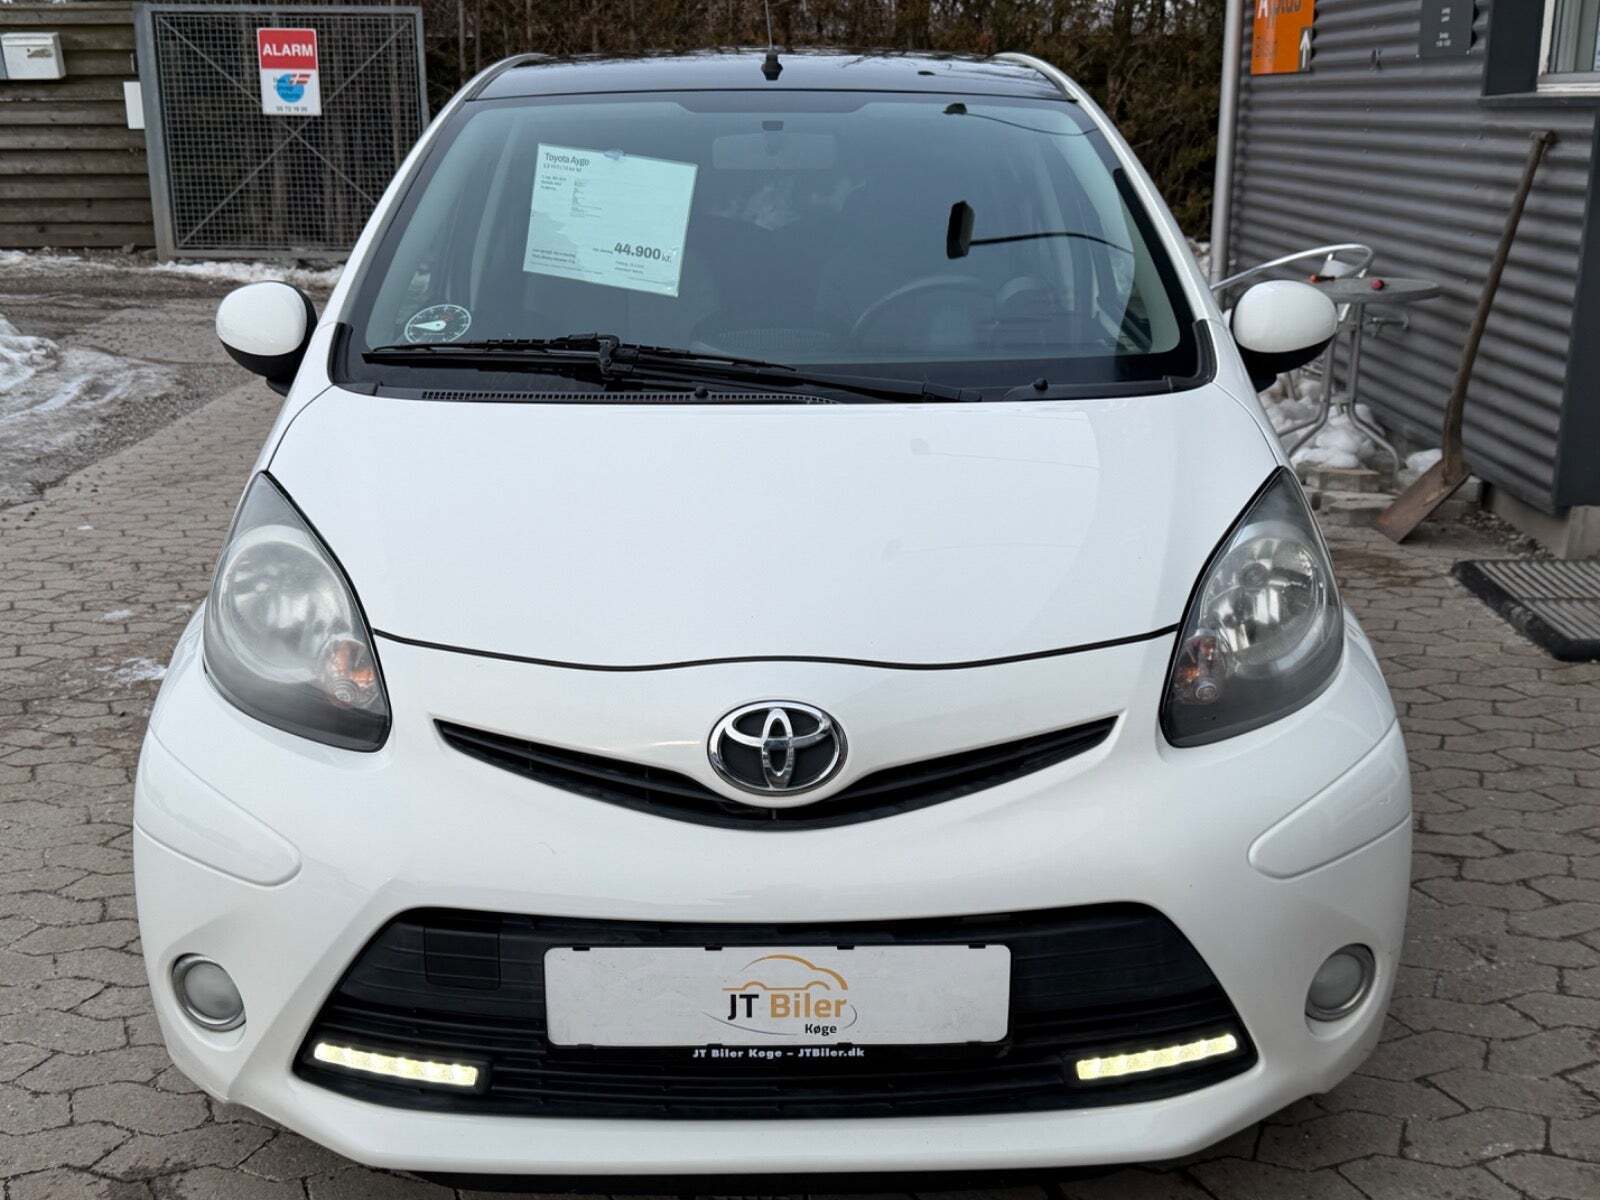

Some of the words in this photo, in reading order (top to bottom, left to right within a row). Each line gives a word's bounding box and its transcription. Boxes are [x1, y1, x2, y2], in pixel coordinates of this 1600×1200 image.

[262, 43, 313, 57] ALARM
[544, 152, 570, 164] Toyota
[570, 156, 591, 168] Aygo
[614, 242, 661, 260] 44.900
[727, 993, 760, 1021] JT
[769, 992, 848, 1019] Biler
[804, 1023, 838, 1037] Køge
[692, 1048, 707, 1058] JT
[711, 1048, 744, 1058] Biler
[797, 1047, 865, 1058] JTBiler.dk
